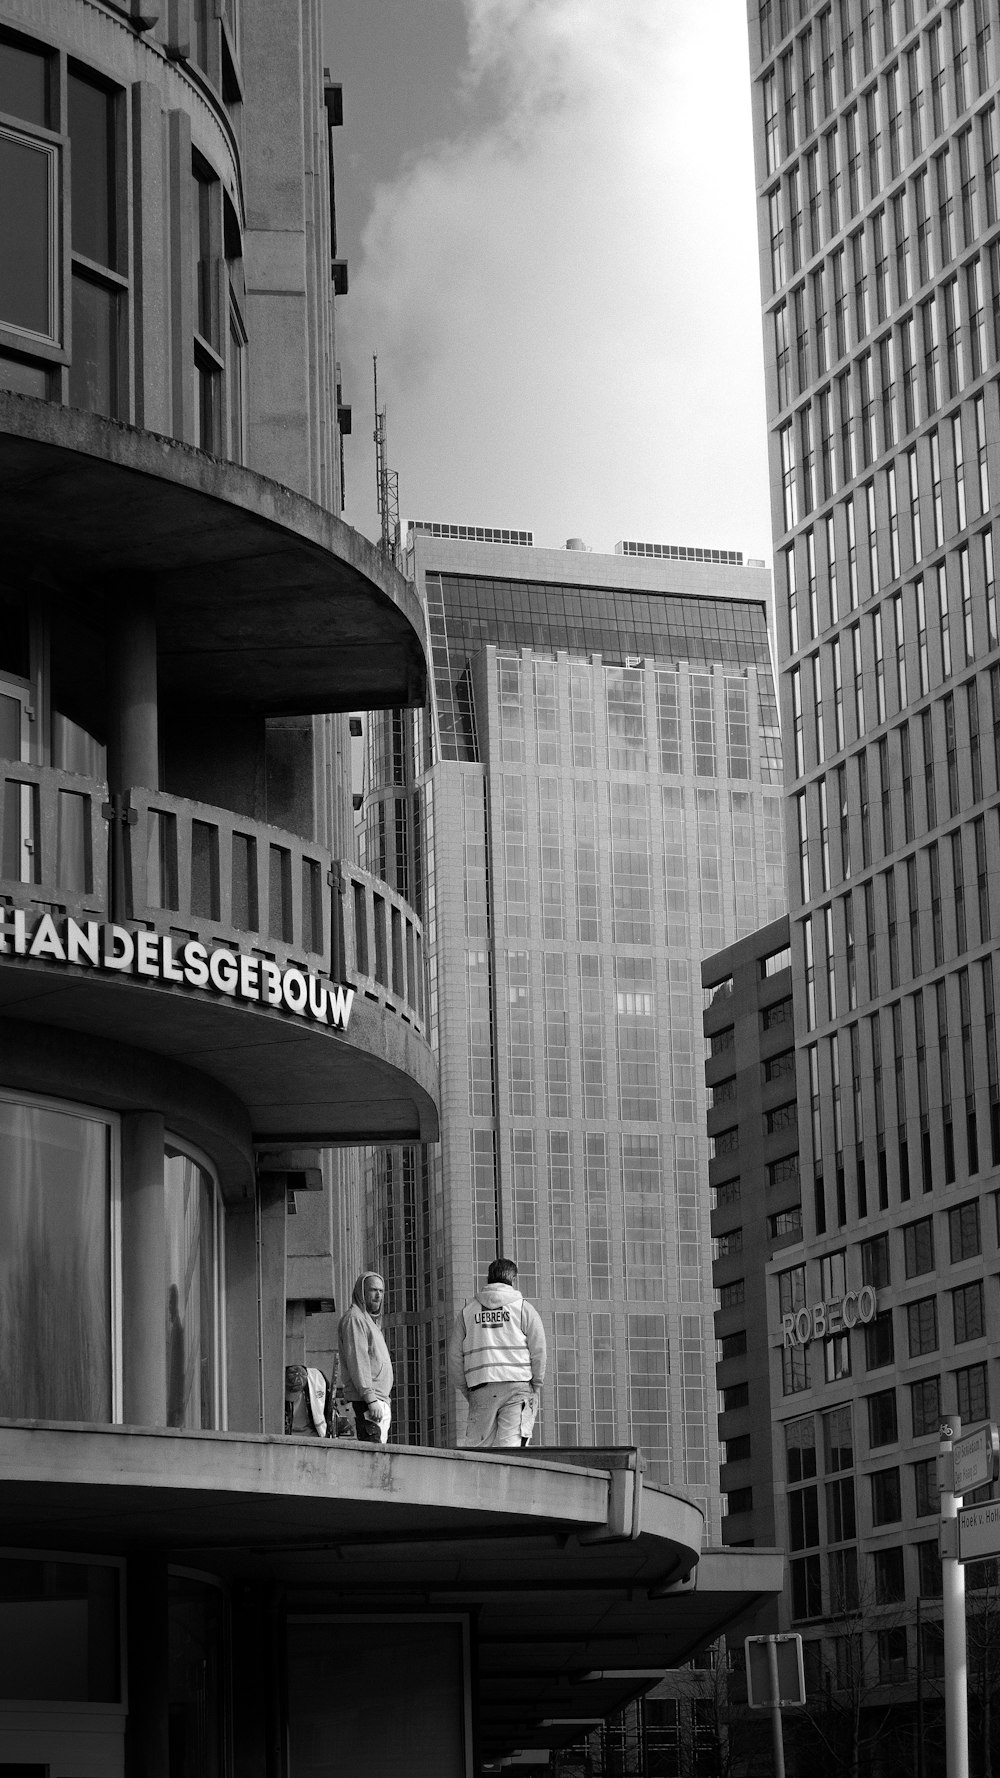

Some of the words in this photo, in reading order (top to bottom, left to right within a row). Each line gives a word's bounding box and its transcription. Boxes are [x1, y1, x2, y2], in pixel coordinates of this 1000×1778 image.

[474, 1311, 510, 1324] LIEBREKS
[783, 1285, 876, 1349] ROBECO
[962, 1513, 977, 1528] Hoek
[986, 1507, 1000, 1523] Holl
